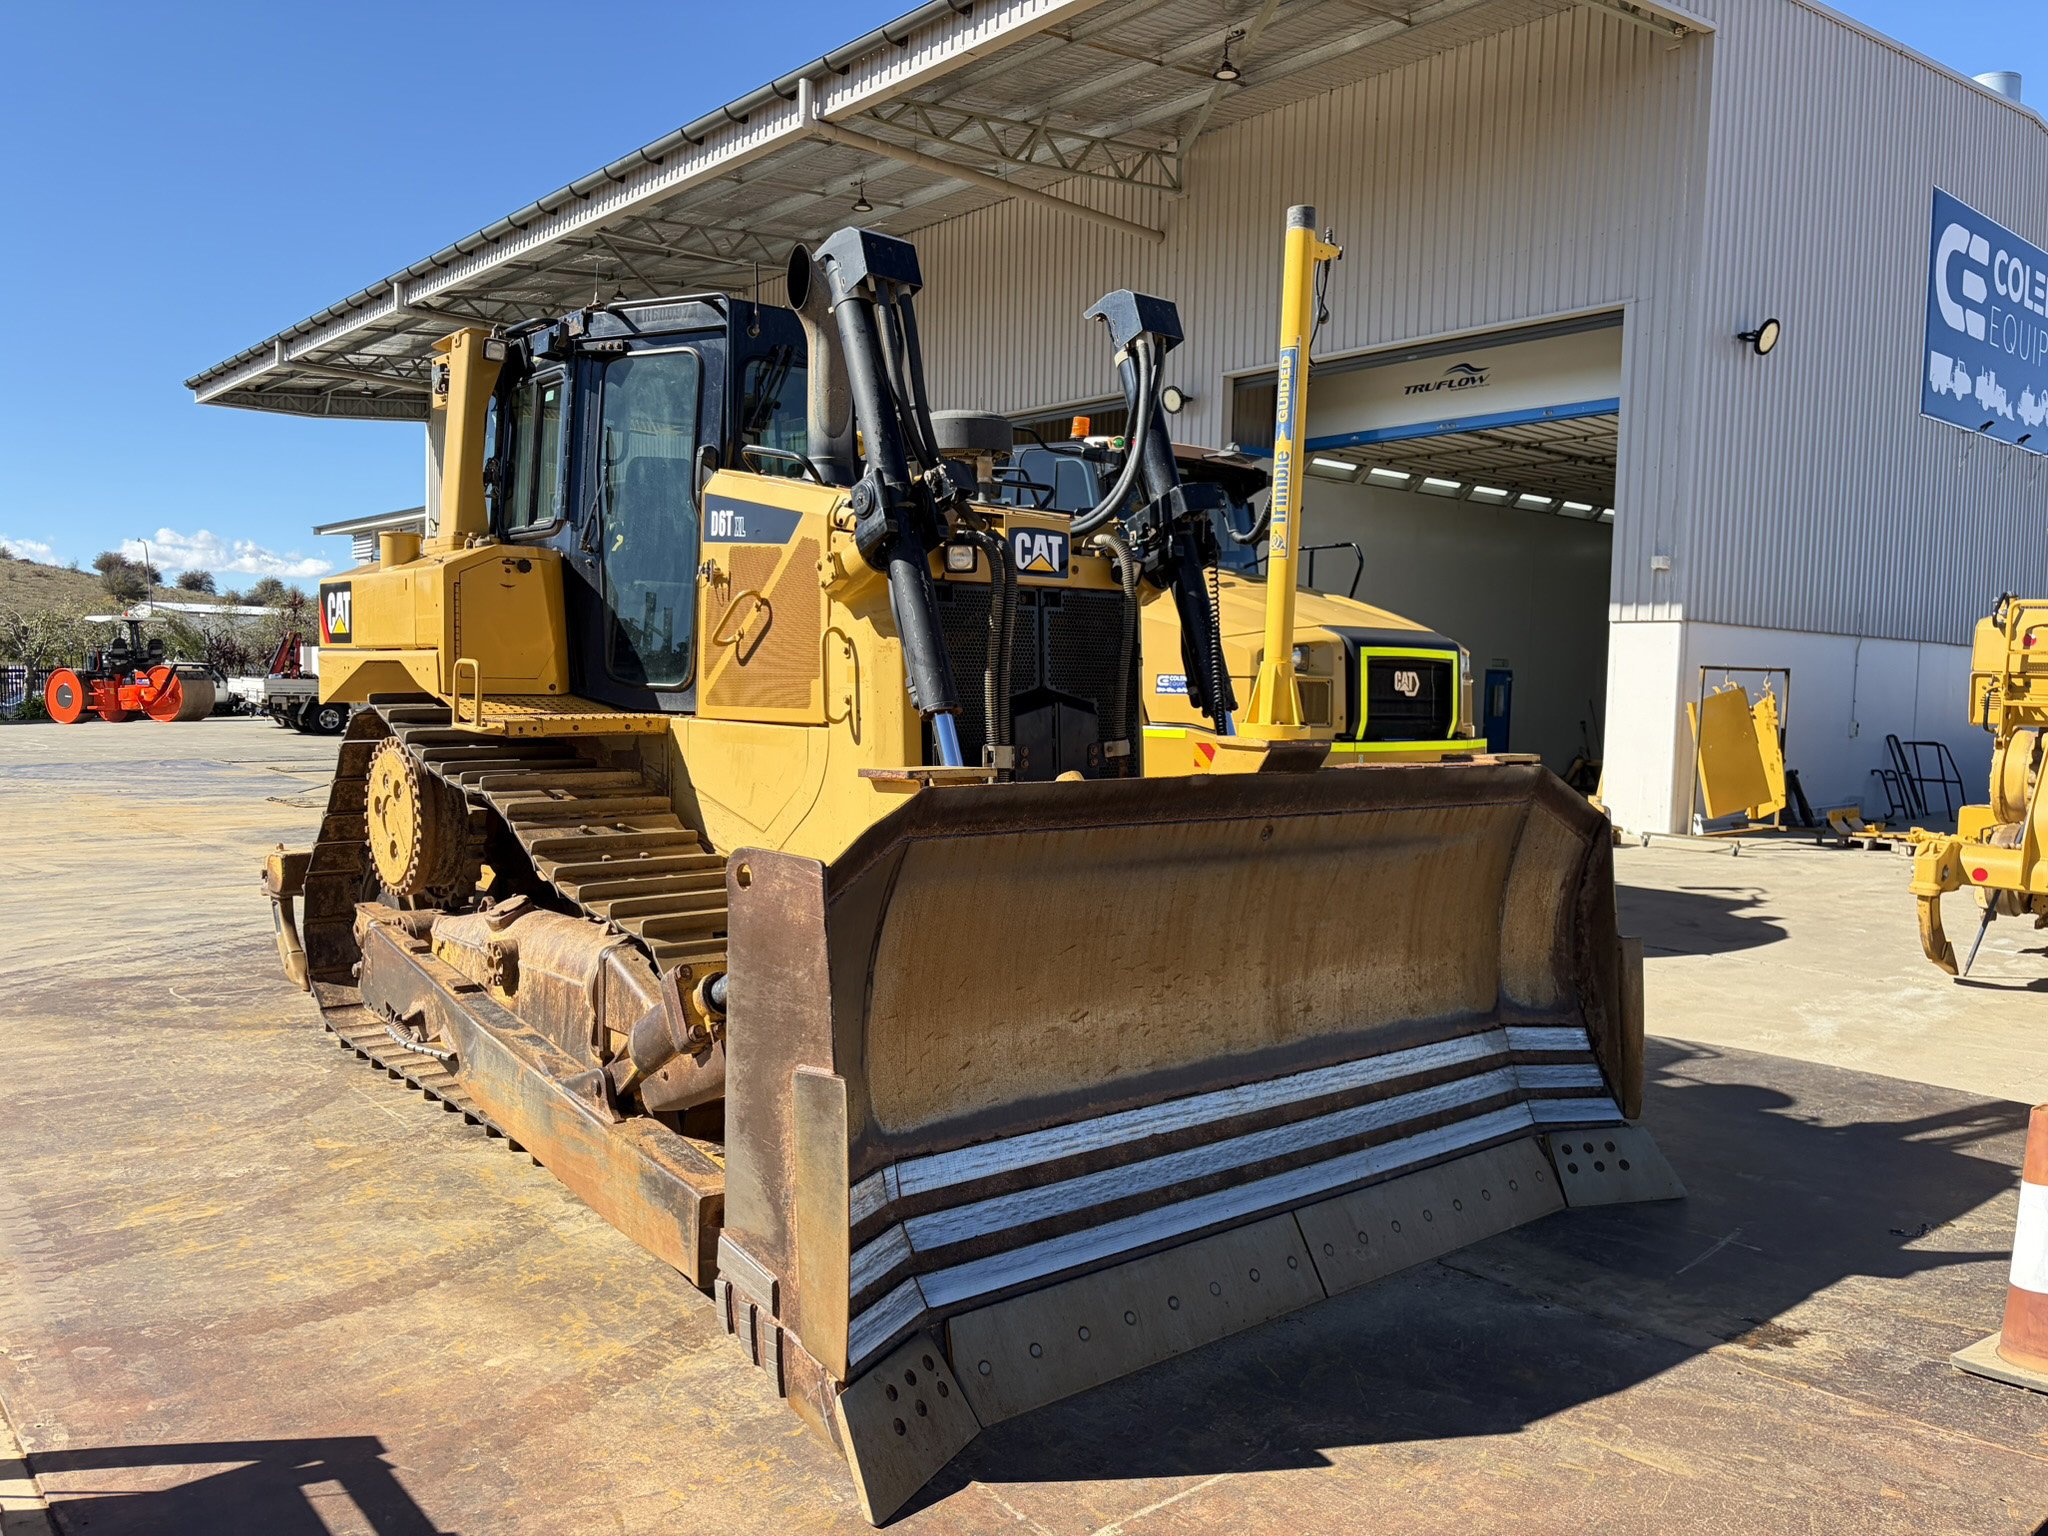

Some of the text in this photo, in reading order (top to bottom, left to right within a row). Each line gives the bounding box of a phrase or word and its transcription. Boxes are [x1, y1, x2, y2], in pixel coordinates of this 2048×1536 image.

[1994, 249, 2048, 318] COLE
[1404, 374, 1491, 395] TRUFLOW
[1272, 355, 1292, 522] Trimble GUIDED
[710, 510, 747, 538] D6T XL
[1015, 532, 1063, 573] CAT
[327, 591, 351, 634] CAT
[1394, 671, 1419, 692] CAT
